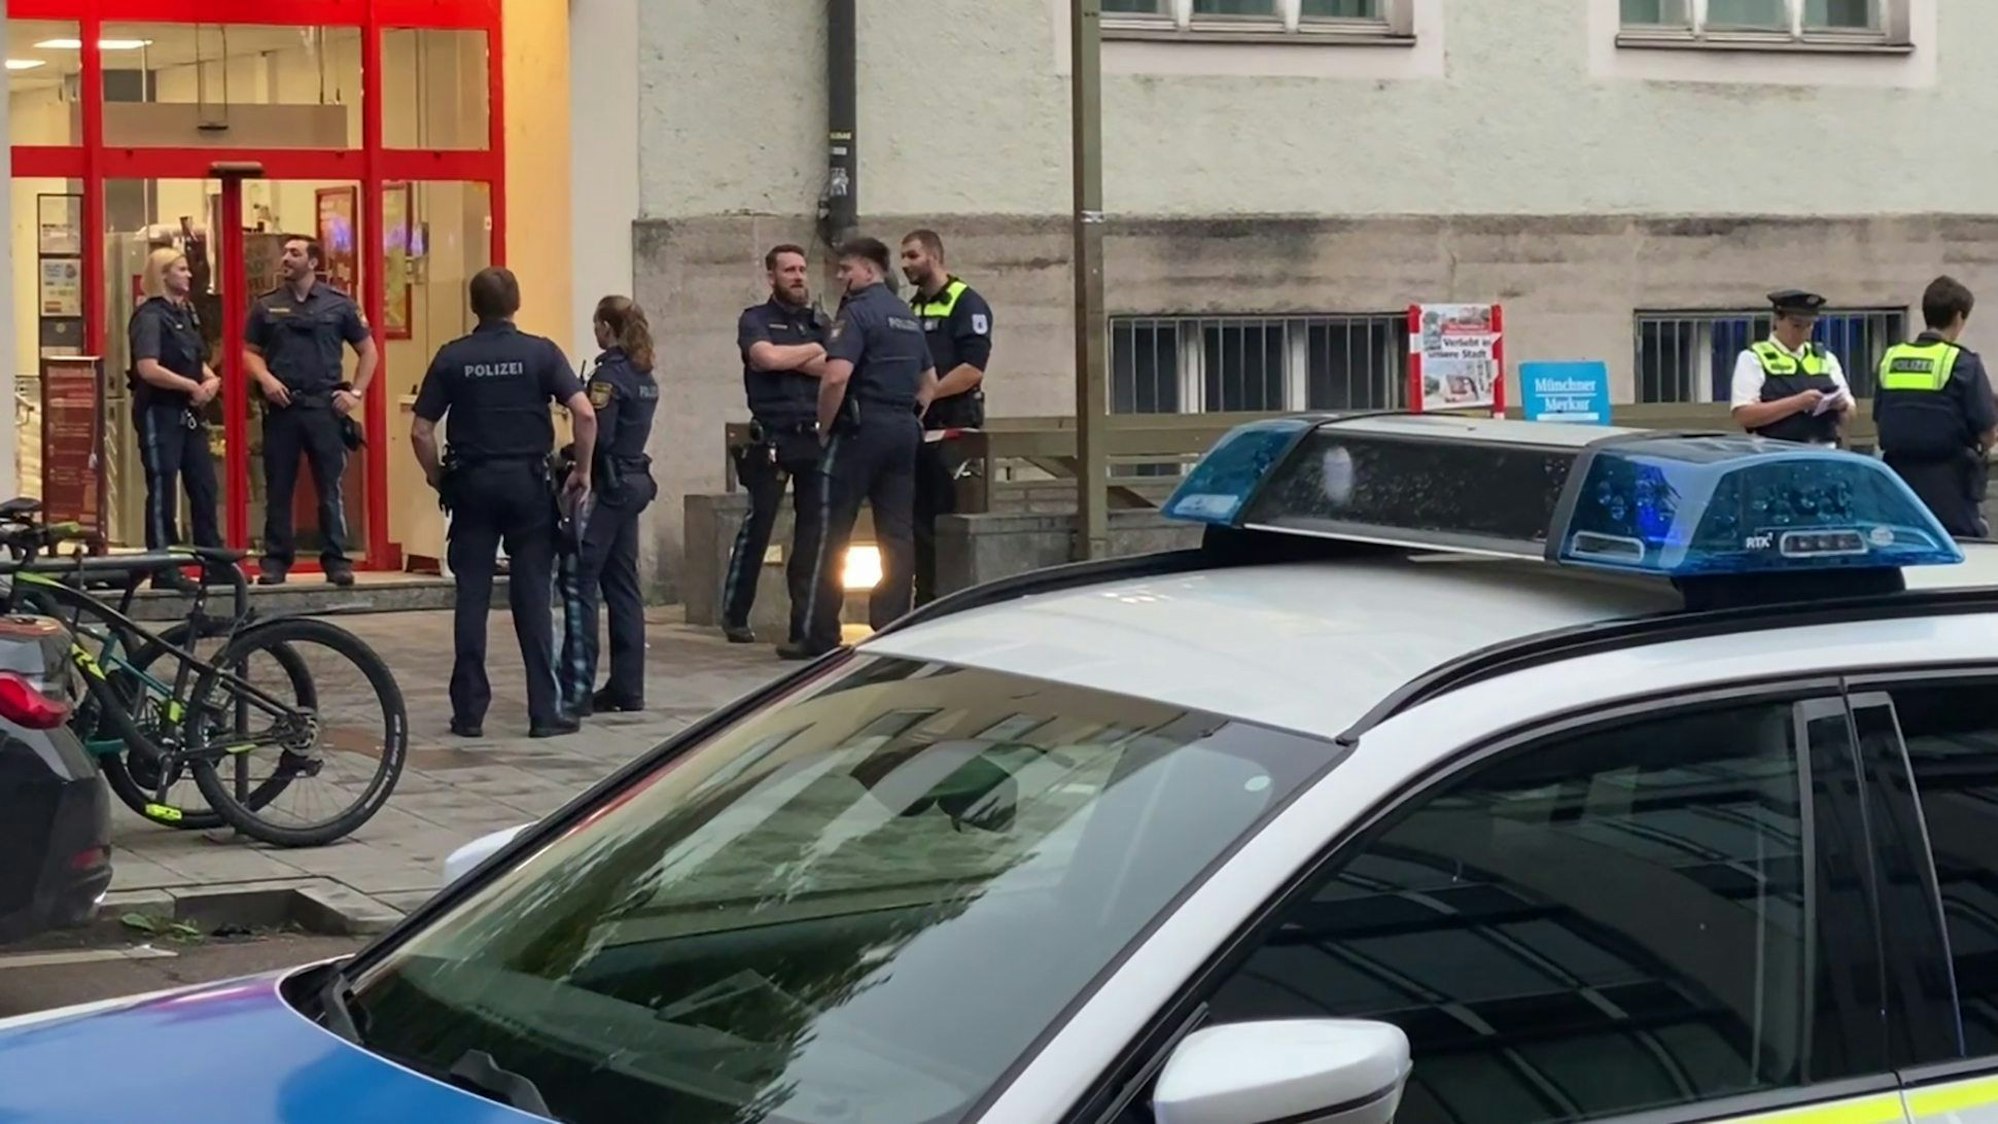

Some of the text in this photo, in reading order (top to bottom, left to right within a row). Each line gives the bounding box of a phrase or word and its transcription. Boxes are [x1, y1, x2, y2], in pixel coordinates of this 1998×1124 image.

[1462, 350, 1486, 358] Stadt
[464, 362, 523, 377] POLIZEI
[1534, 376, 1596, 392] Münchner
[1545, 397, 1590, 412] Merkur
